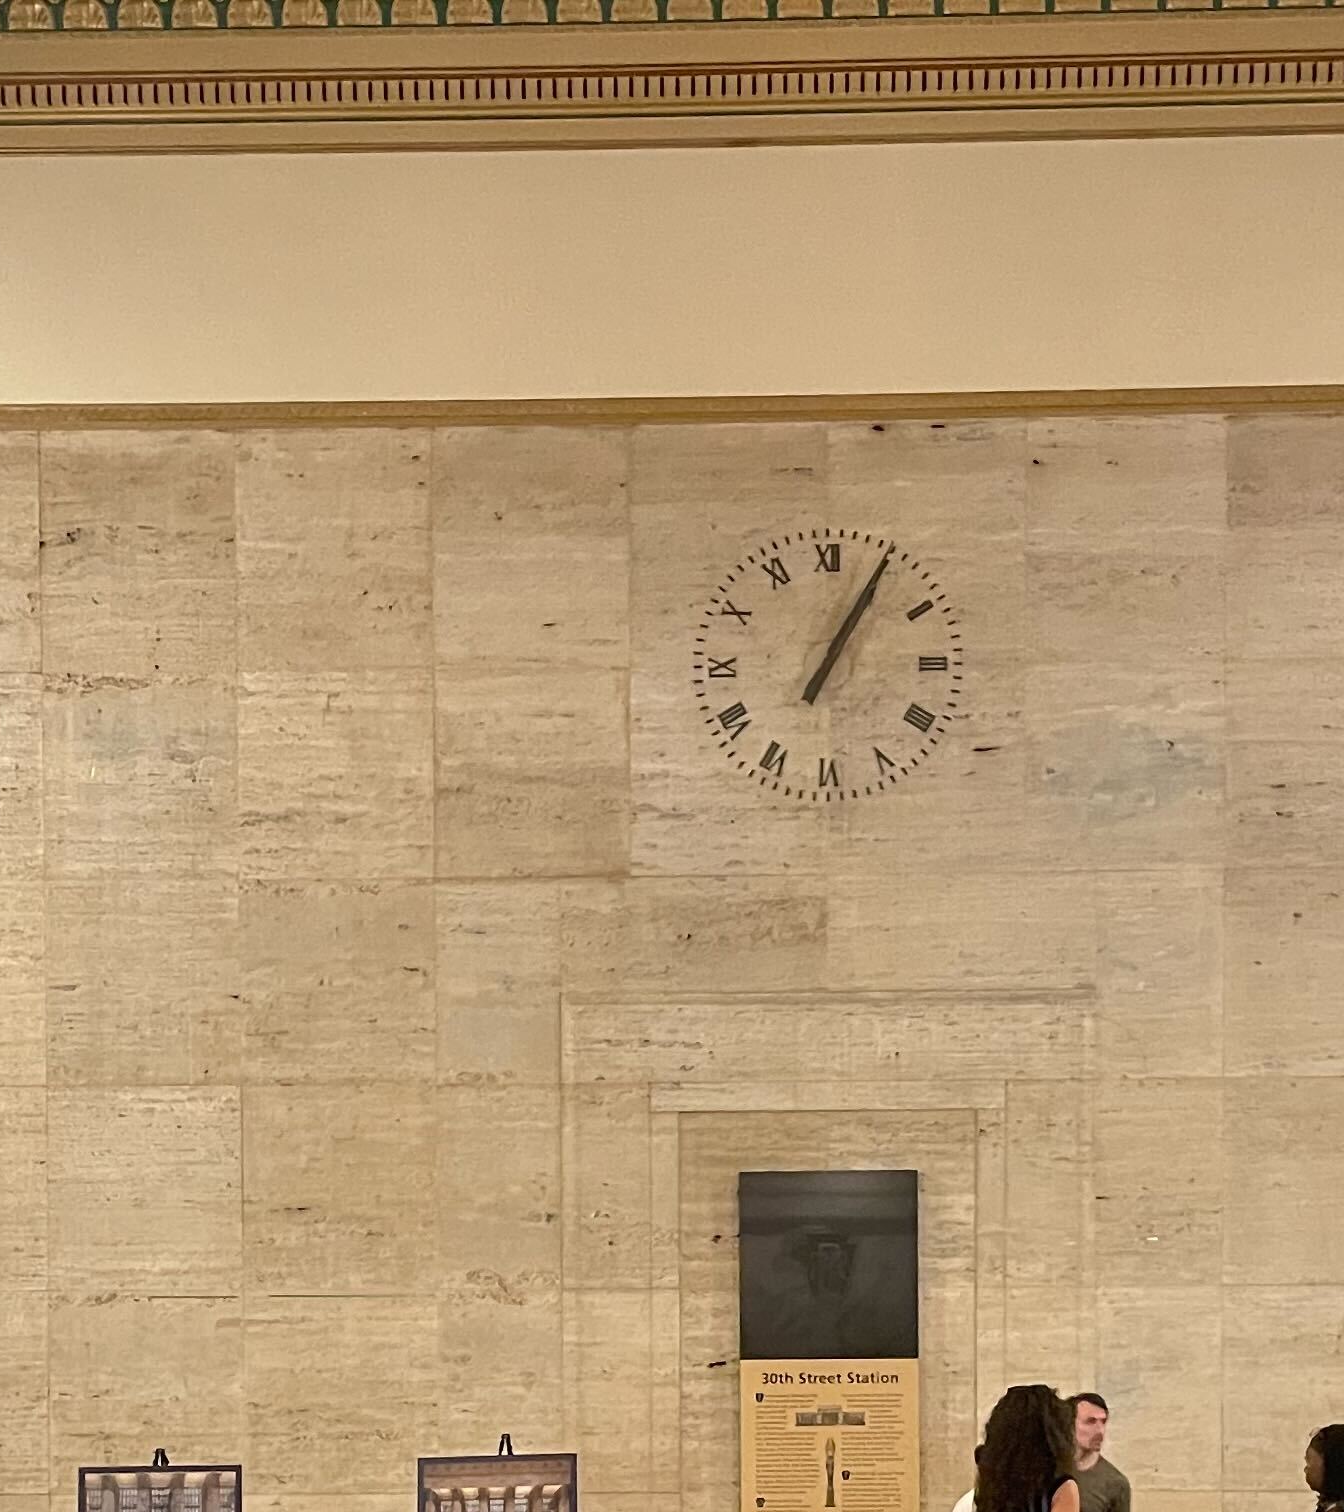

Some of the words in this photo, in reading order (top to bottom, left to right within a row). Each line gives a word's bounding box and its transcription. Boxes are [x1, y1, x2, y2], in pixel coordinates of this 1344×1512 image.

[814, 544, 841, 572] XII
[761, 557, 791, 589] XI
[722, 600, 752, 625] X
[708, 657, 737, 678] IX
[918, 656, 948, 672] III
[718, 702, 752, 740] VIII
[904, 703, 936, 732] IIII
[759, 740, 788, 777] VII
[818, 758, 839, 787] VI
[873, 746, 896, 776] V
[762, 1372, 794, 1384] 30th
[799, 1372, 842, 1384] Street
[847, 1372, 899, 1384] Station
